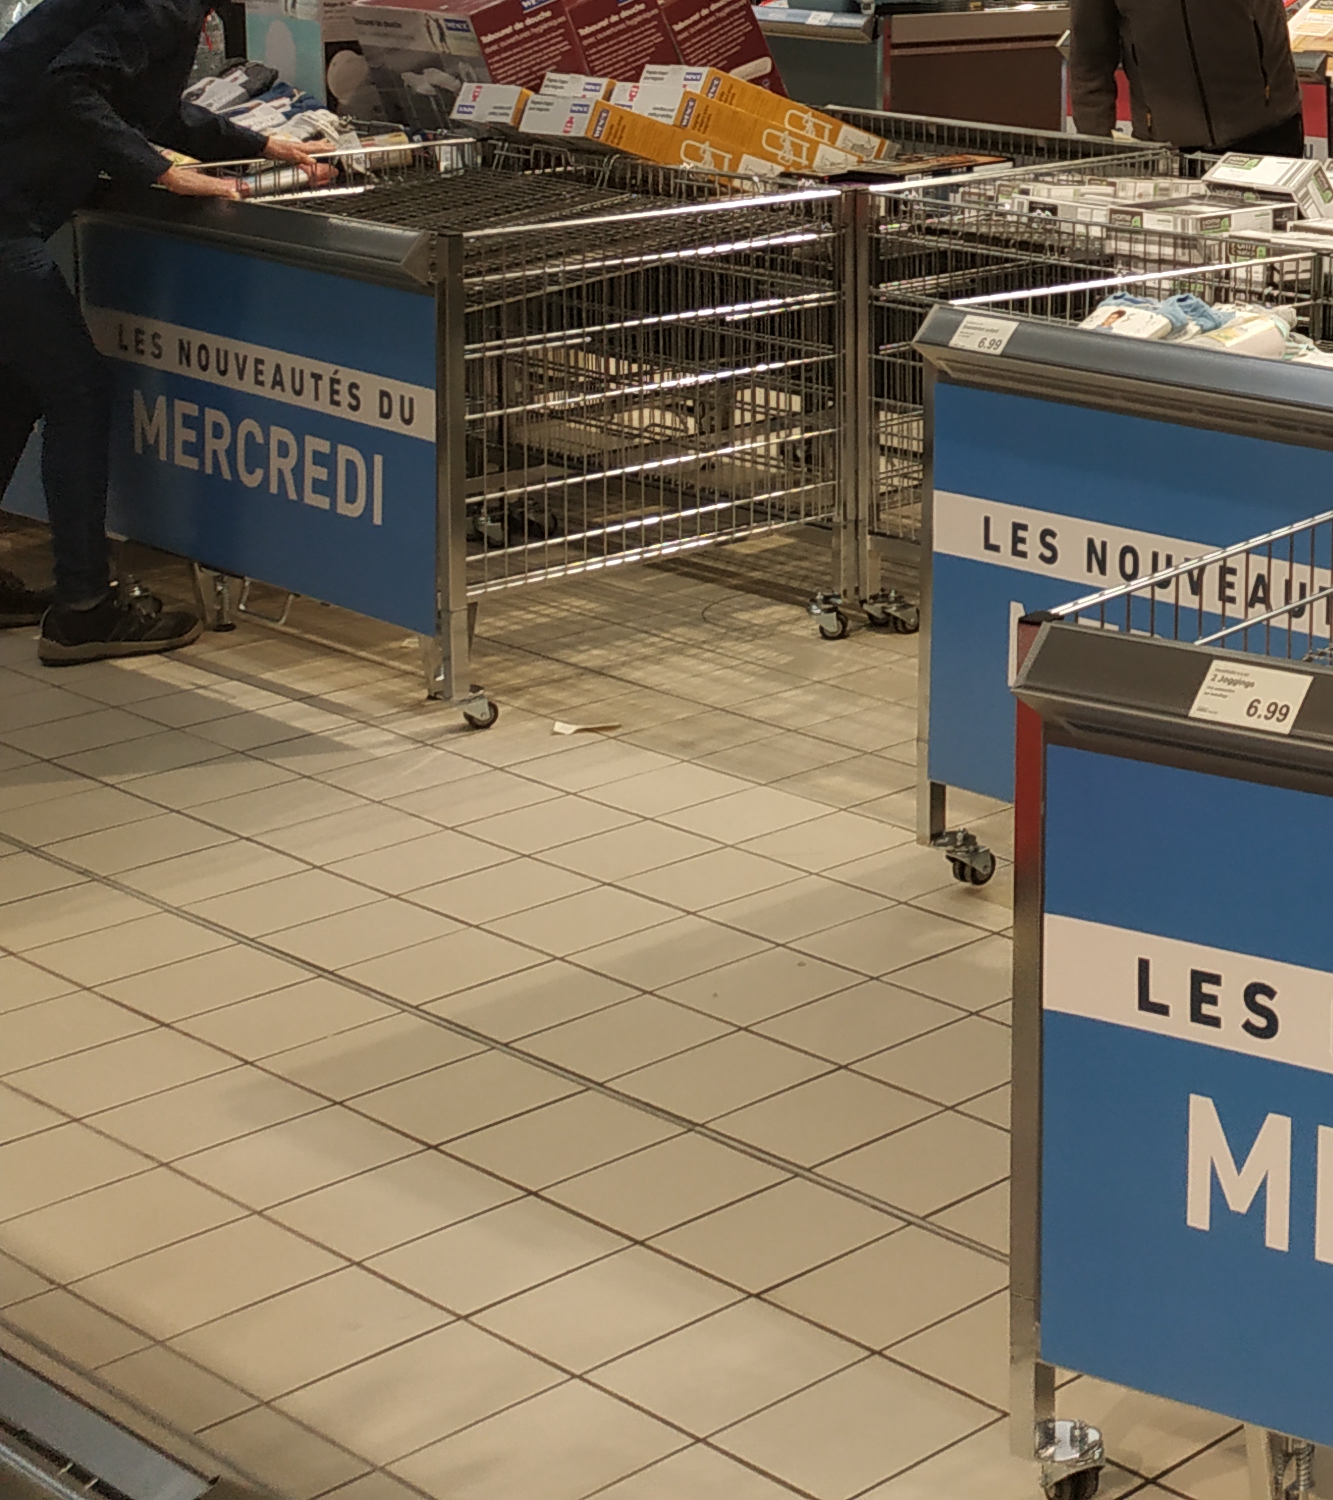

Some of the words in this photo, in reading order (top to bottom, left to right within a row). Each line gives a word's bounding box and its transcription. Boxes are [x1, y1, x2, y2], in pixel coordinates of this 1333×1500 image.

[977, 336, 1003, 351] 6.99
[117, 323, 164, 360] LES
[178, 337, 361, 412] NOUVEAUTÉS
[378, 389, 415, 426] DU
[132, 389, 384, 527] MERCREDI
[983, 515, 1058, 565] LES
[1217, 674, 1256, 689] Joggings
[1246, 698, 1291, 723] 6.99
[1133, 954, 1283, 1041] LES
